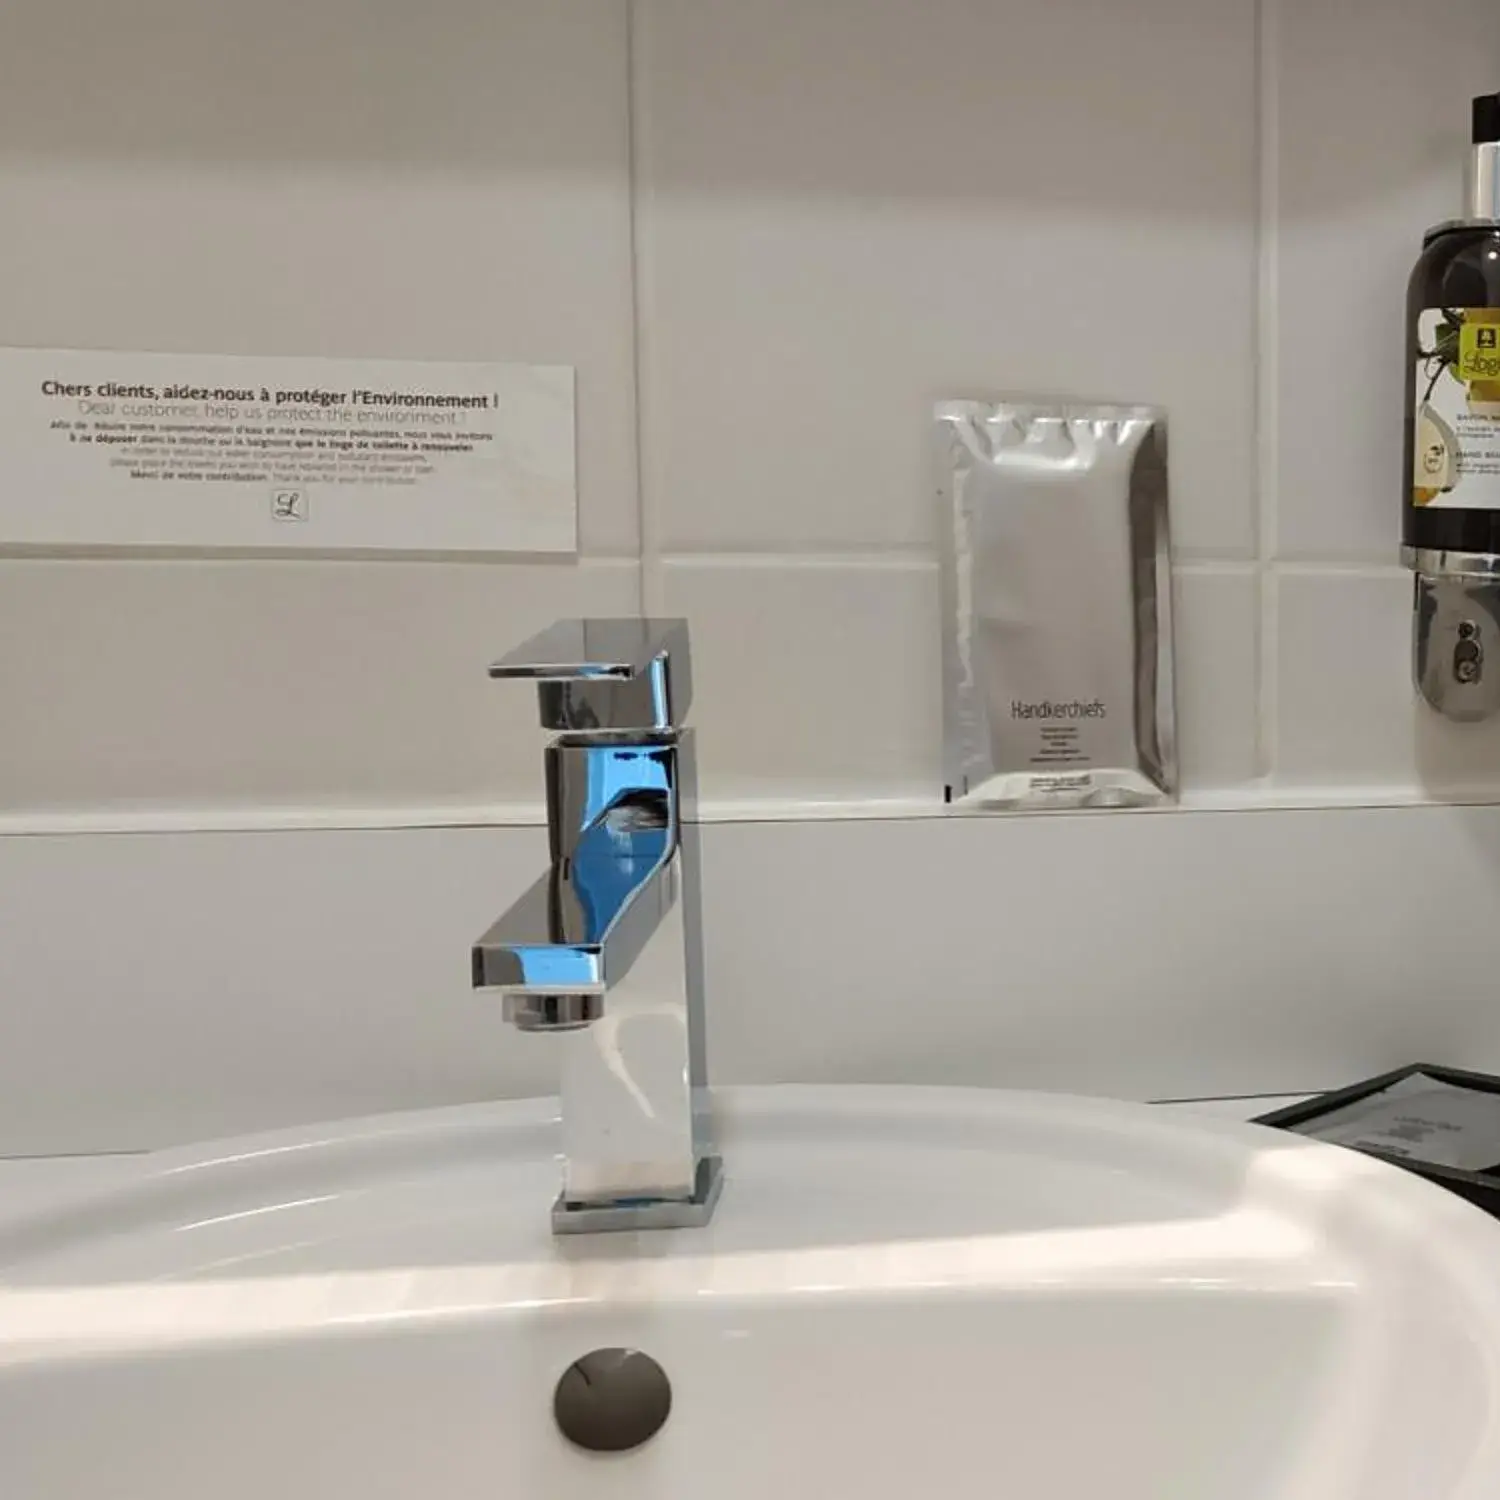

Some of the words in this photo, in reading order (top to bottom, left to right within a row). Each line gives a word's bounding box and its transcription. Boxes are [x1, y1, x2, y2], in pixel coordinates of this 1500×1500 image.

[41, 380, 92, 397] Chers
[97, 383, 159, 401] clients,
[163, 384, 255, 401] aidez-nous
[259, 387, 270, 402] à
[275, 389, 347, 407] protéger
[352, 389, 489, 408] l'Environnement
[79, 400, 116, 415] Dear
[204, 403, 239, 421] help
[243, 407, 262, 419] us
[266, 407, 322, 422] protect
[325, 408, 352, 423] the
[357, 411, 456, 425] environment
[1011, 698, 1106, 720] Handkerchiefs
